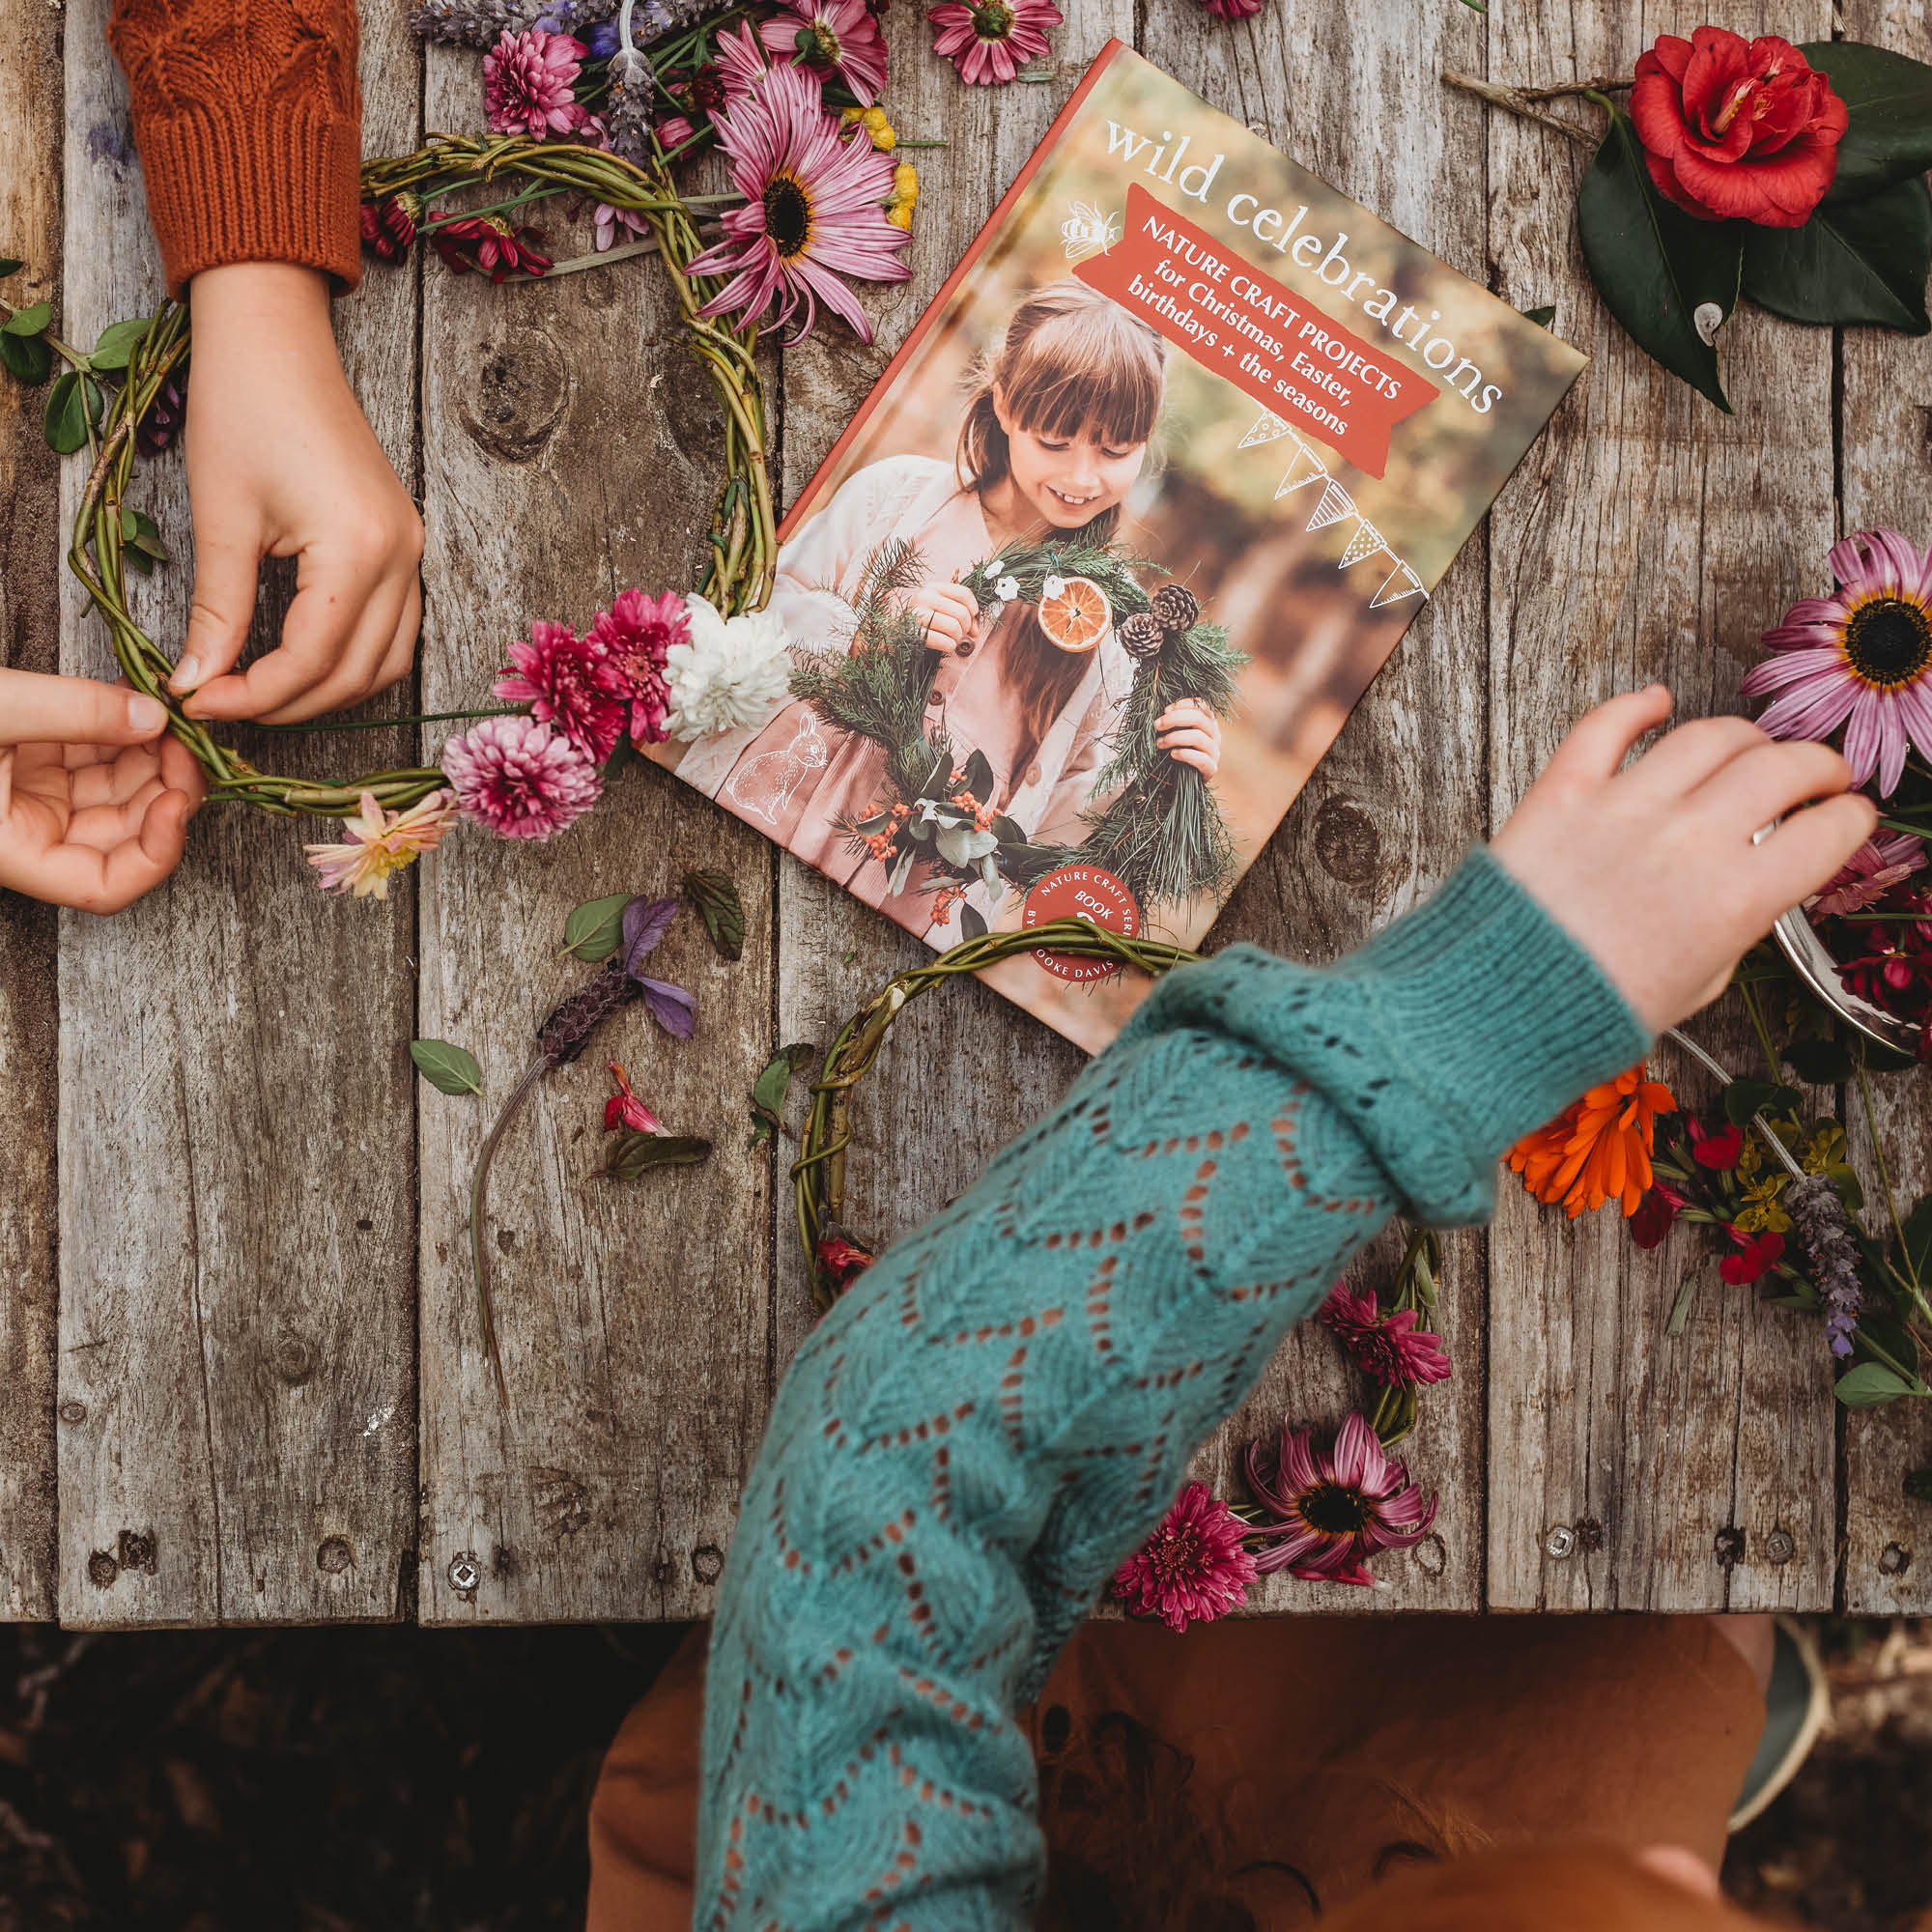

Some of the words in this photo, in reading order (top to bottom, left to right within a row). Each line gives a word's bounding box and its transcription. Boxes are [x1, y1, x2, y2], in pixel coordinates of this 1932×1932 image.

[1105, 120, 1225, 204] wild
[1227, 192, 1502, 413] celebrations
[1142, 215, 1231, 283] NATURE
[1230, 275, 1300, 329] CRAFT
[1298, 321, 1402, 401] PROJECTS
[1152, 259, 1186, 289] for
[1188, 282, 1285, 363] Christmas,
[1291, 350, 1352, 407] Easter,
[1127, 274, 1218, 348] birthdays
[1221, 342, 1236, 358] +
[1238, 351, 1272, 386] the
[1273, 379, 1349, 437] seasons
[1027, 910, 1036, 925] BY
[1074, 959, 1114, 979] DAVIS
[1040, 871, 1089, 896] NATURE
[1094, 874, 1126, 904] CRAFT
[1074, 890, 1114, 920] BOOK
